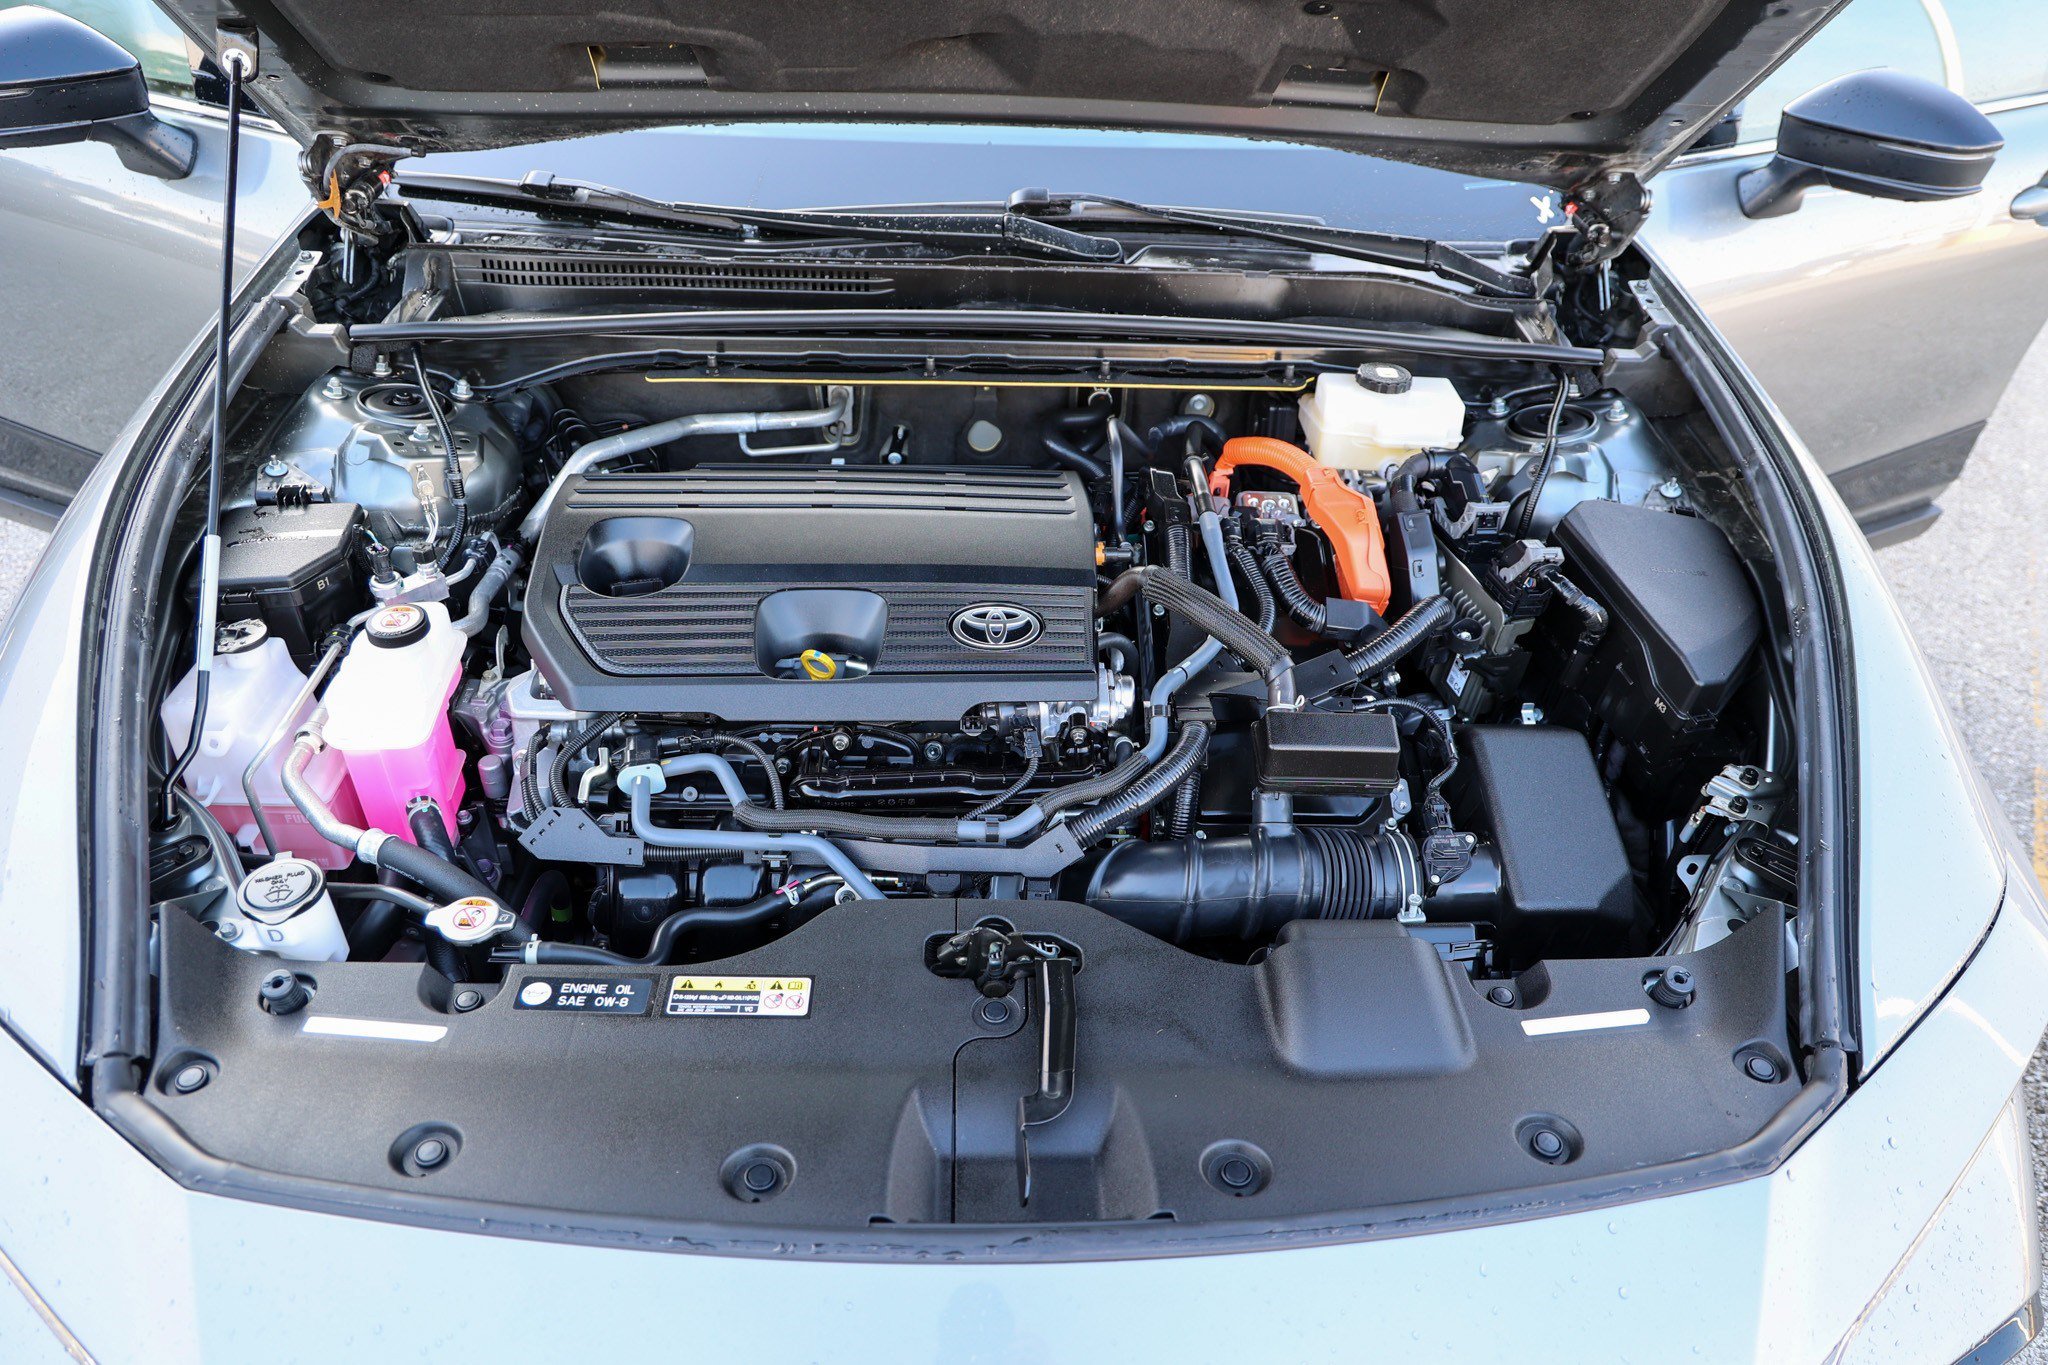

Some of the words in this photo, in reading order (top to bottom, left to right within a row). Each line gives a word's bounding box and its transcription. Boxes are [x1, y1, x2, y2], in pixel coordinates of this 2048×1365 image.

[317, 576, 330, 591] B1
[1654, 697, 1667, 713] M3
[284, 814, 310, 824] FUL
[560, 983, 608, 994] ENGINE
[615, 984, 635, 995] OIL
[557, 996, 587, 1006] SAE
[594, 997, 630, 1007] 0W-8
